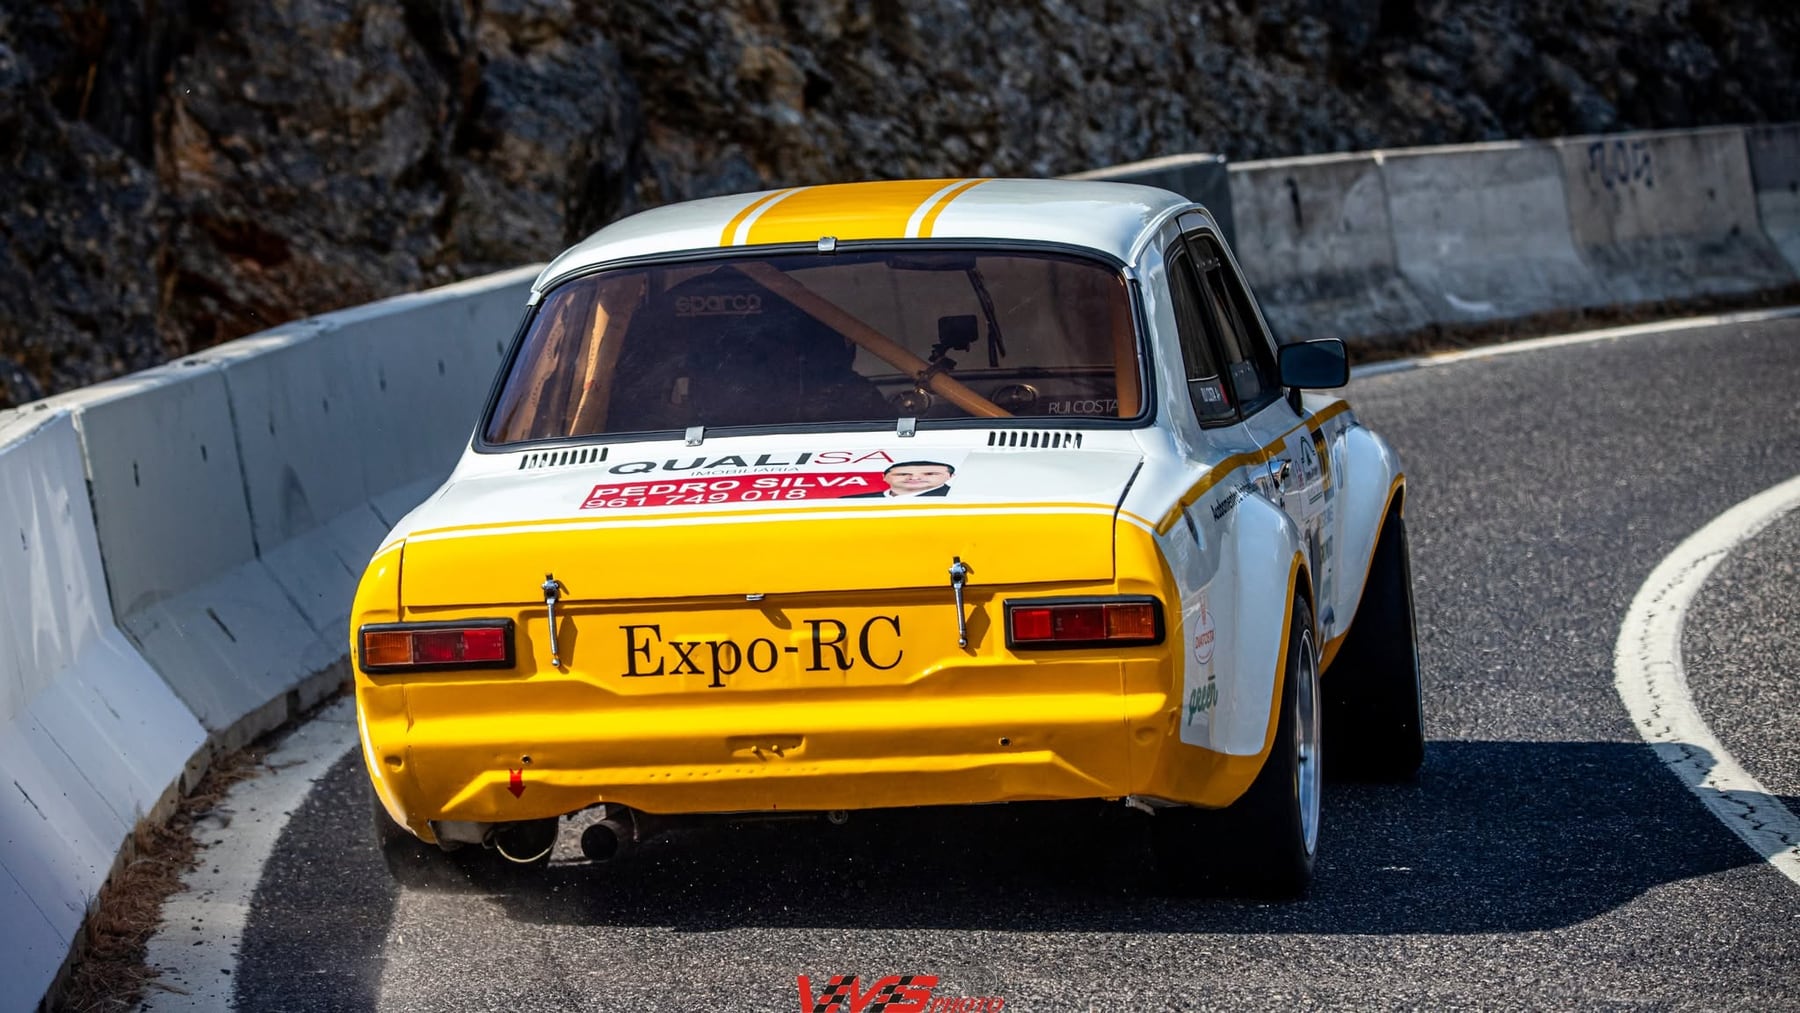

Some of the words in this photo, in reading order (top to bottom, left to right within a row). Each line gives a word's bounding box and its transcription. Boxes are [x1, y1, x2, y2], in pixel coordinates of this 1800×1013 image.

[675, 294, 762, 314] sparco
[1048, 402, 1071, 414] RUI
[1073, 400, 1119, 414] COSTA
[608, 449, 894, 475] QUALISA
[585, 497, 647, 509] 961
[664, 492, 729, 506] 749
[741, 488, 807, 501] 018
[592, 480, 740, 499] PEDRO
[752, 476, 868, 489] SILVA
[619, 614, 903, 688] Expo-RC
